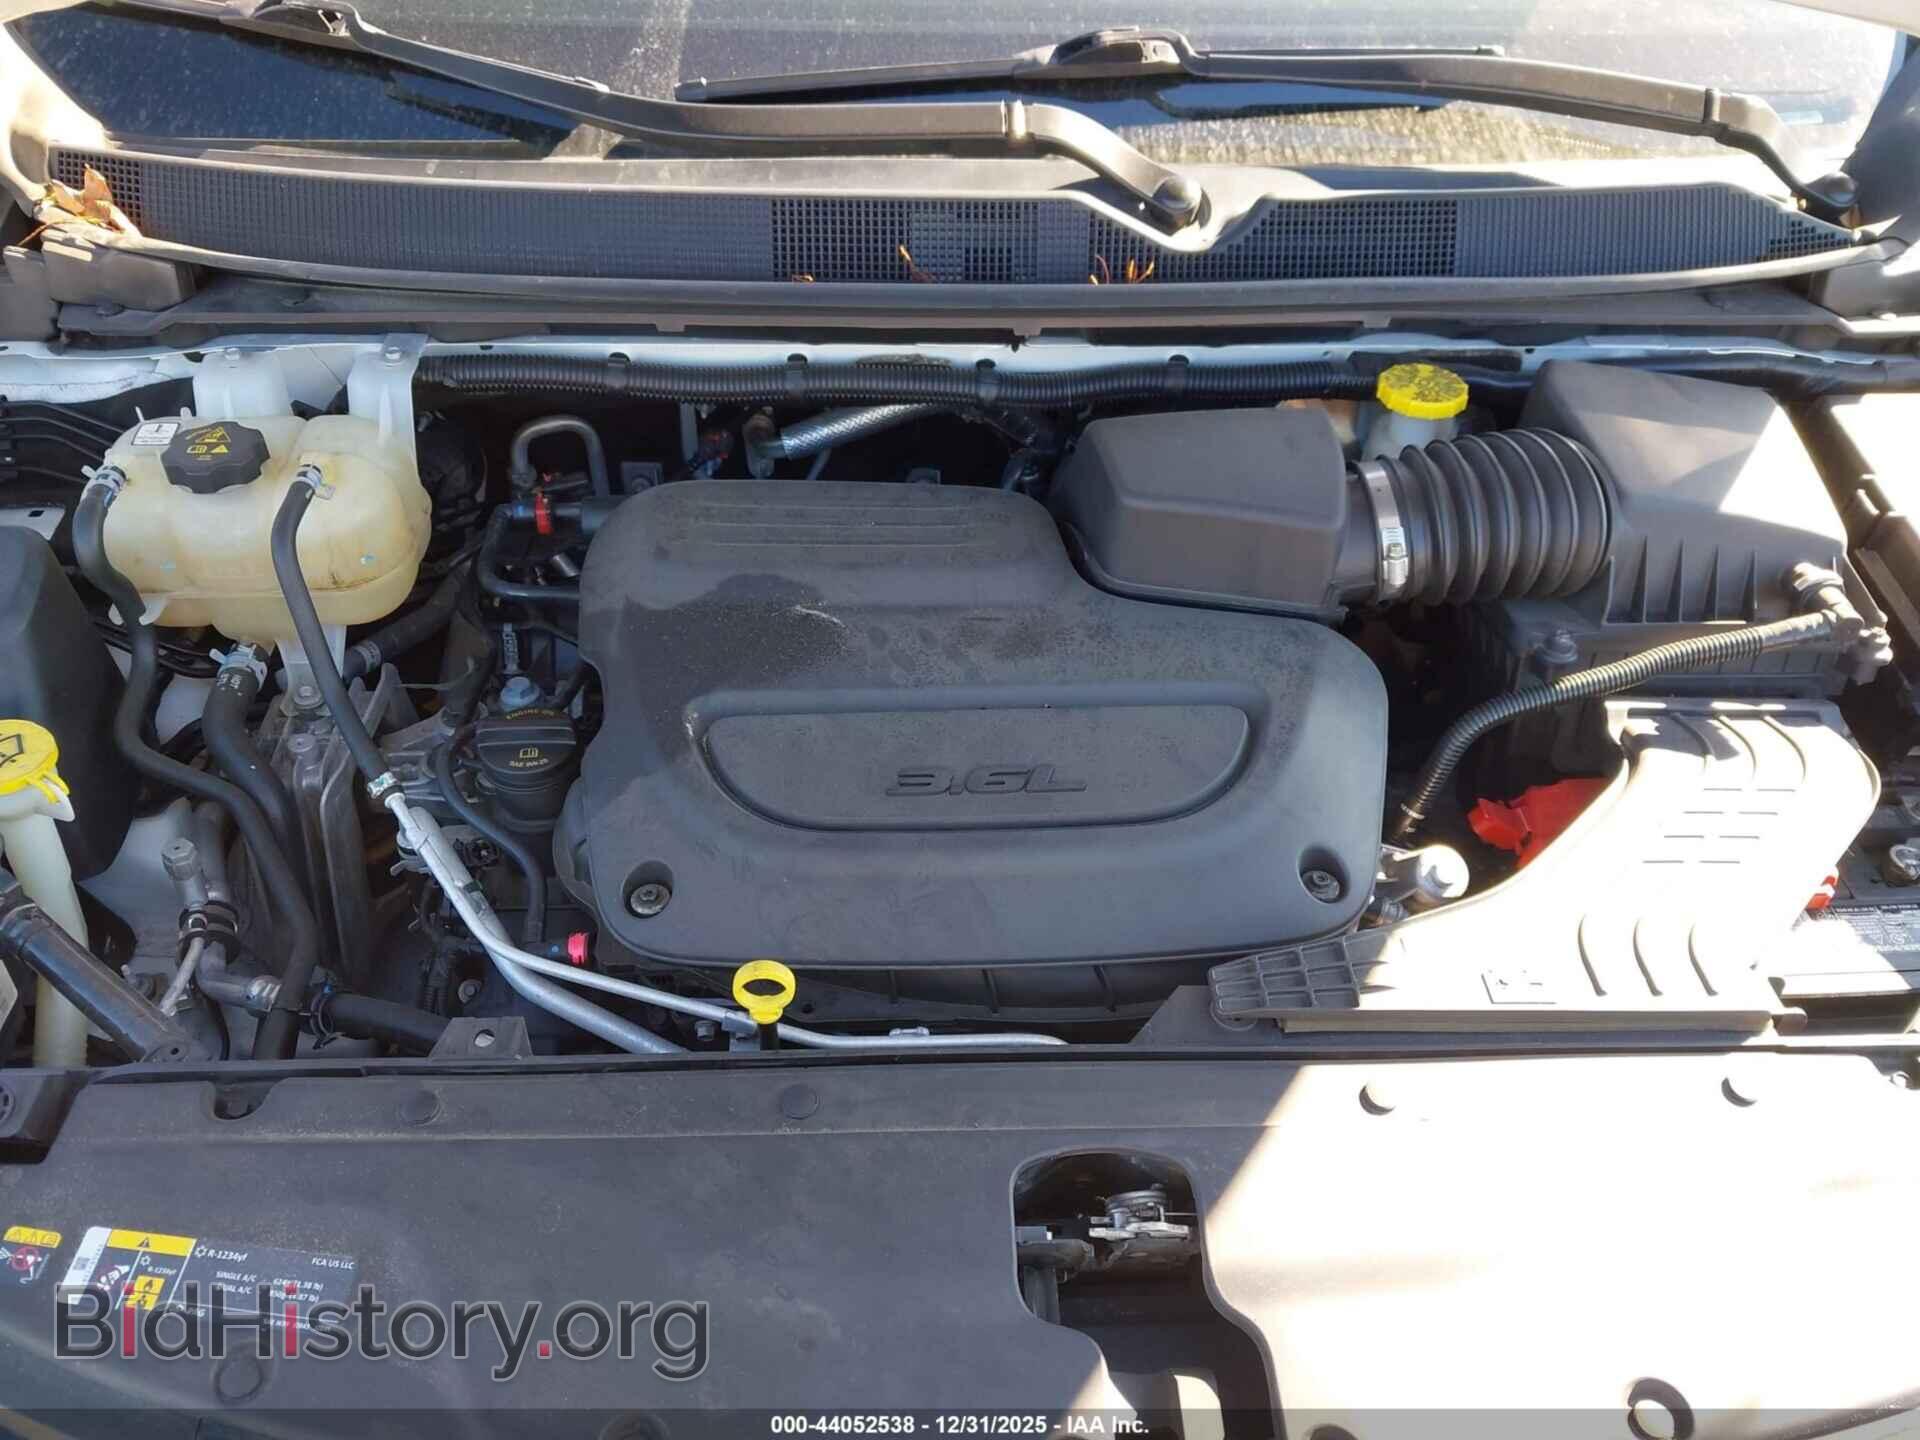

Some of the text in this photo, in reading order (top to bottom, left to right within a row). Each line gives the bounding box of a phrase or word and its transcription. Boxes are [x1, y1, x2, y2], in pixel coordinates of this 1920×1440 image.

[885, 764, 1088, 796] 3.6L
[207, 1248, 355, 1270] R-1234yf FCA US LLC
[215, 1271, 241, 1281] SINGLE
[241, 1273, 257, 1283] A/C
[237, 1285, 253, 1295] A/C
